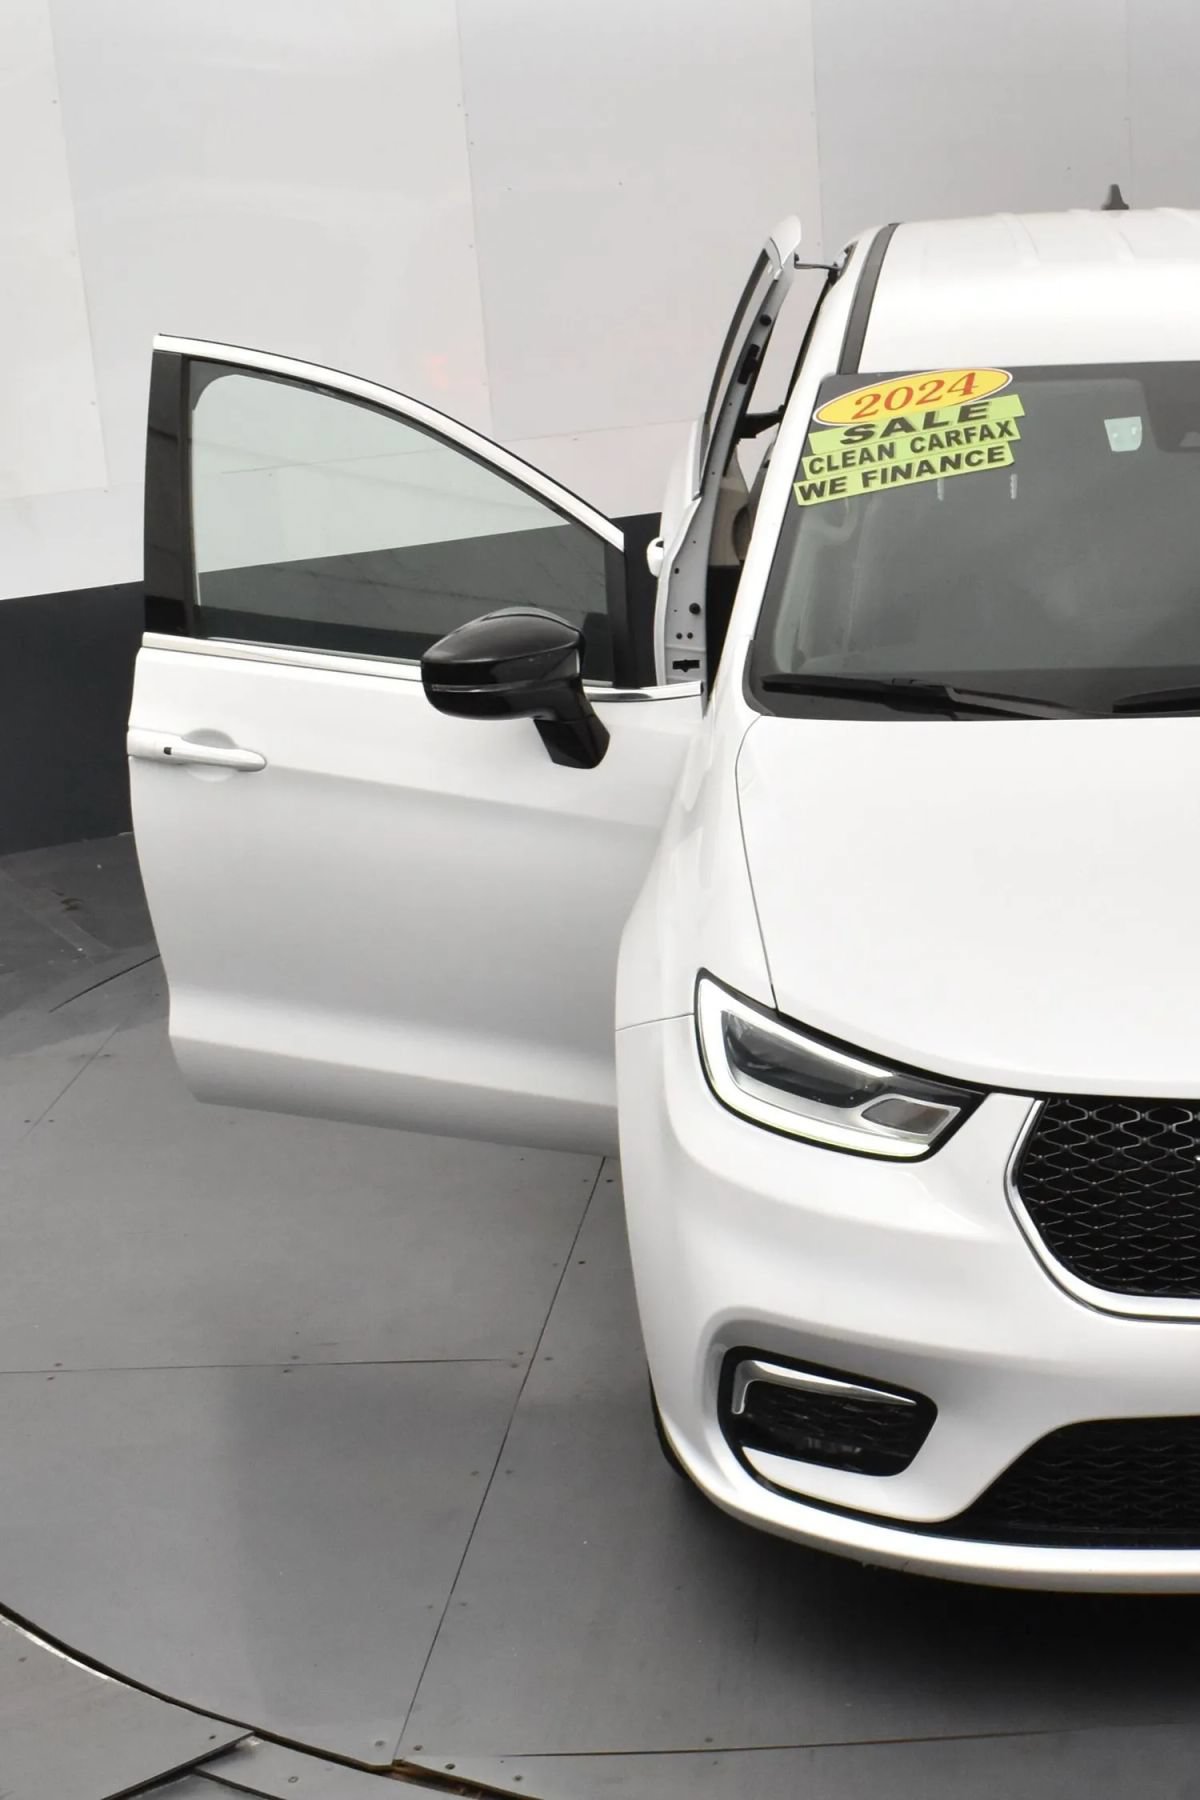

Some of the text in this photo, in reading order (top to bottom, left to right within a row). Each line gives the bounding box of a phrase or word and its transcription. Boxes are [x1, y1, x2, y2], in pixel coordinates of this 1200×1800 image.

[851, 372, 978, 420] 2024
[809, 420, 1014, 475] CLEAN CARFAX
[840, 402, 989, 444] SALE
[799, 446, 1005, 501] WE FINANCE
